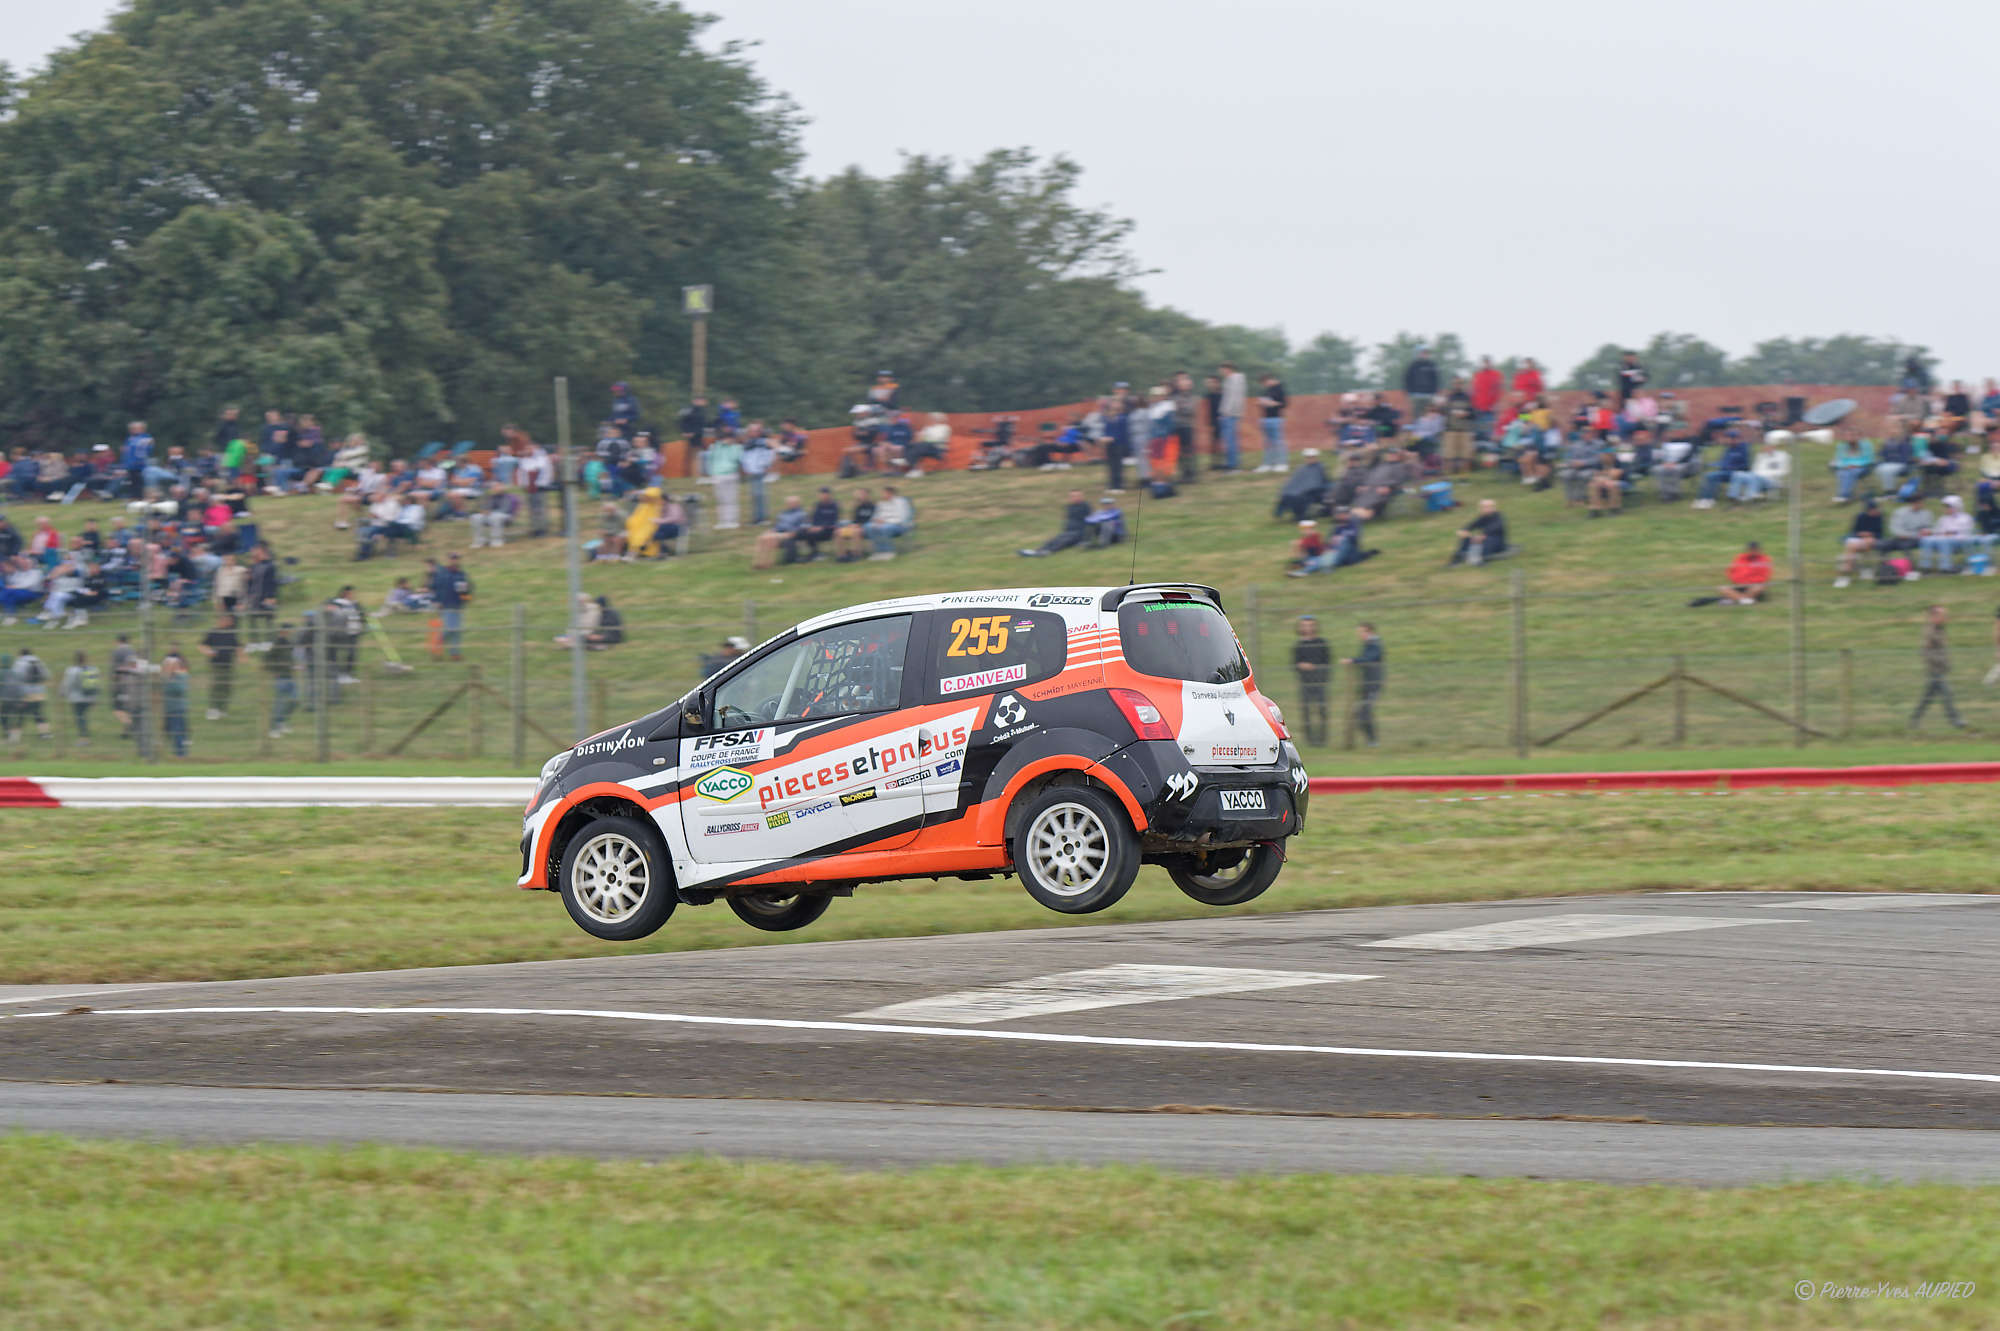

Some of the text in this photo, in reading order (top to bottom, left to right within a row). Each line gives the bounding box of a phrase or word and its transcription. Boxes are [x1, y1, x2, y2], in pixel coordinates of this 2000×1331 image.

[951, 594, 1019, 603] INTERSPORT
[946, 615, 1011, 657] 255
[943, 666, 1024, 693] C.DANVEAU
[577, 728, 646, 757] DISTINXION
[694, 731, 756, 751] FFSA
[691, 747, 760, 762] COUPE DE FRANCE
[945, 748, 964, 760] com
[1212, 744, 1256, 758] piecesetpneus
[690, 758, 731, 769] RALLYCROSS
[758, 726, 967, 810] piecesetpneus
[703, 777, 748, 793] YACCO
[898, 770, 930, 786] FACOM
[1224, 791, 1263, 809] YACCO
[796, 801, 832, 819] DAYCO
[707, 823, 741, 834] RALLYCROSS
